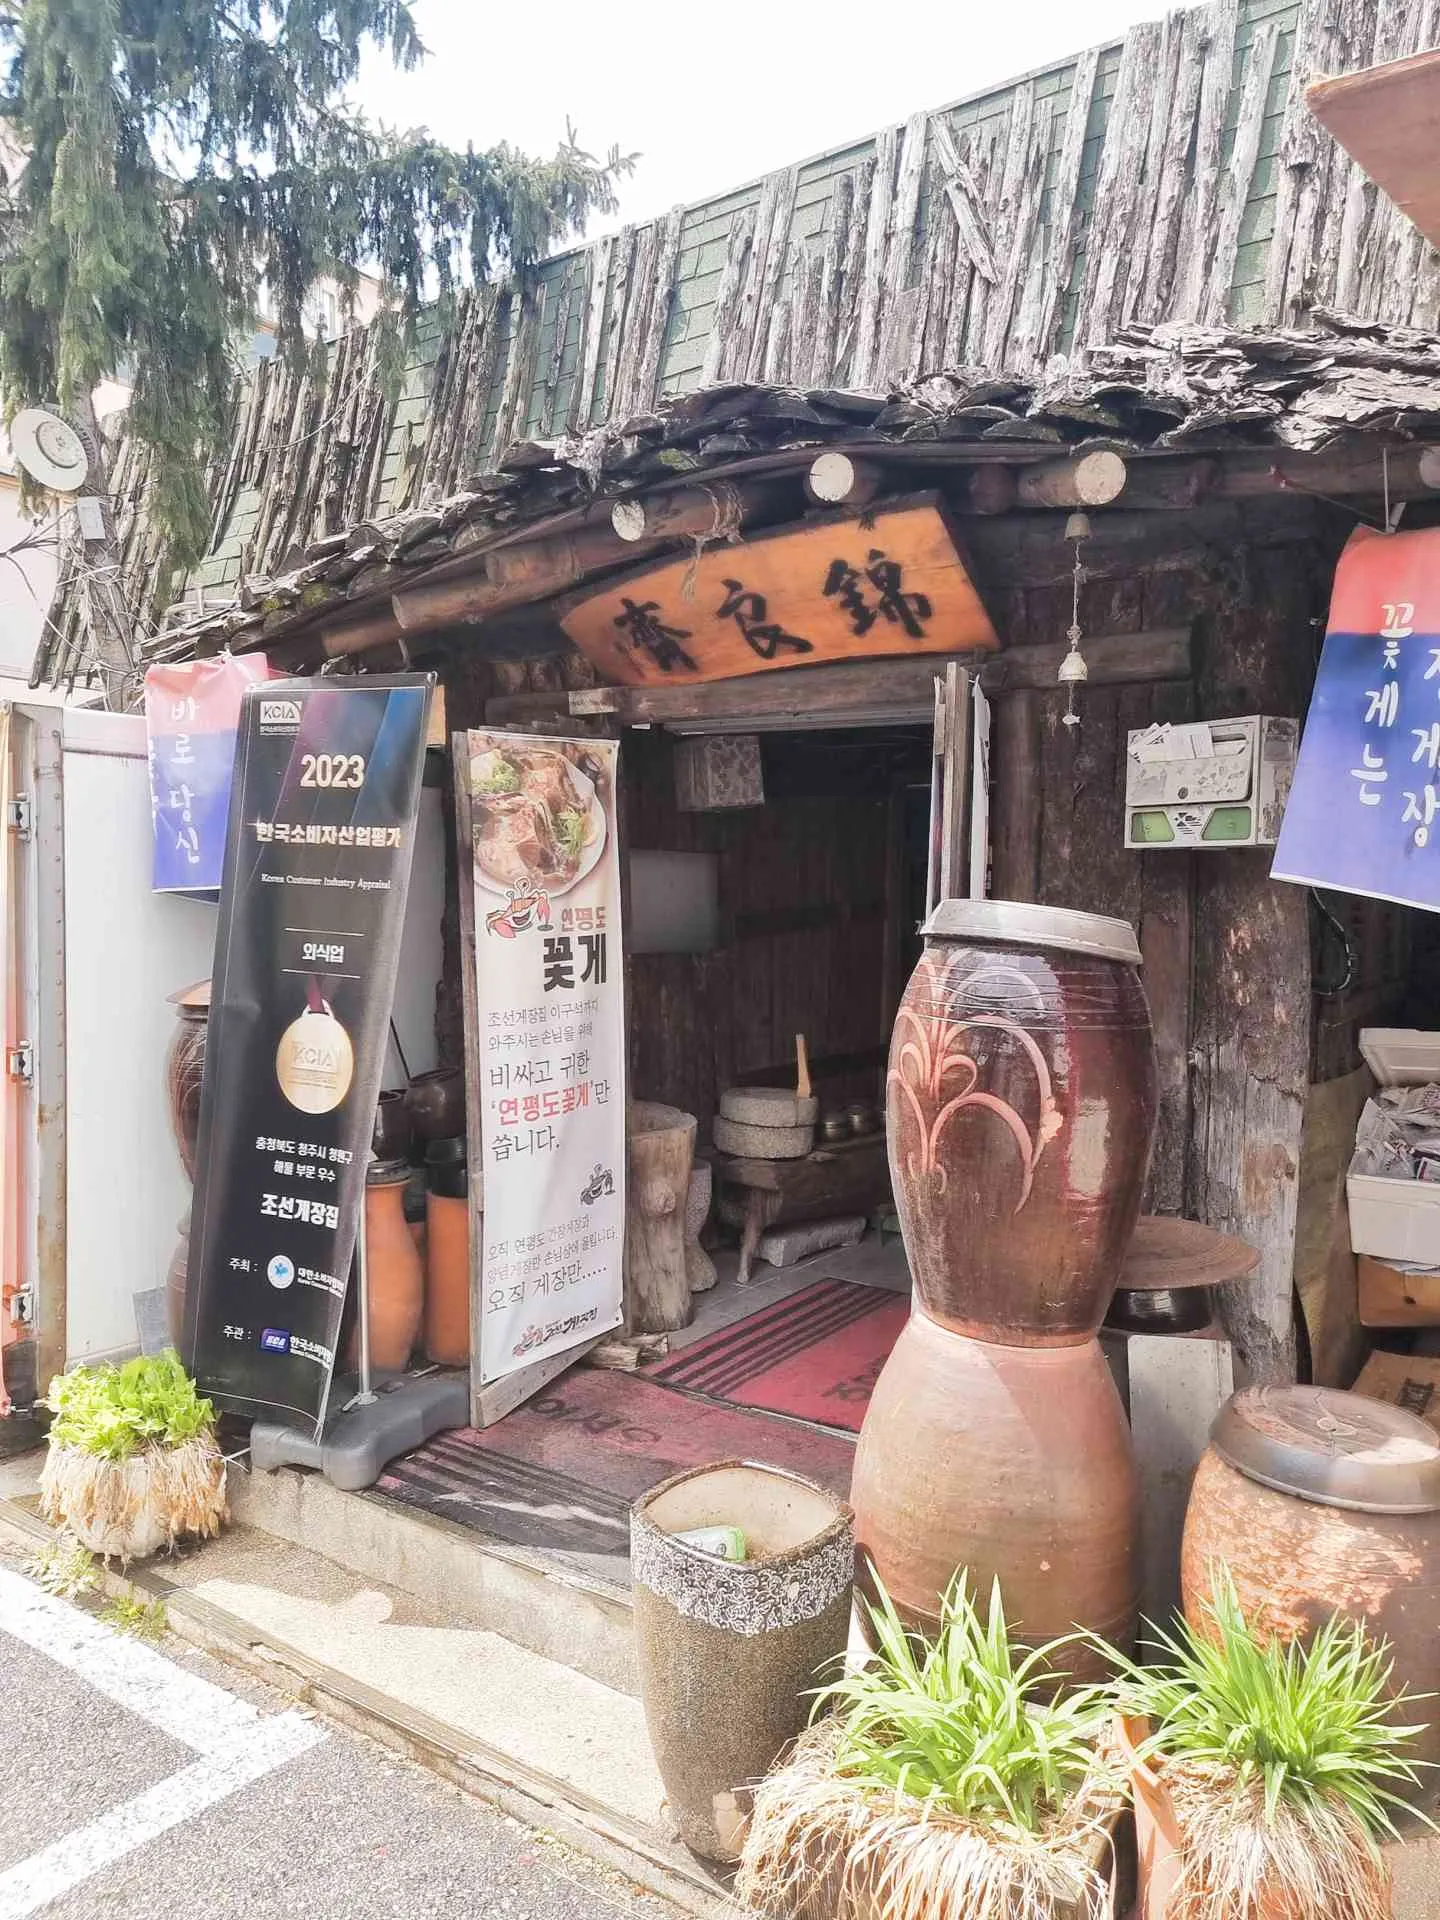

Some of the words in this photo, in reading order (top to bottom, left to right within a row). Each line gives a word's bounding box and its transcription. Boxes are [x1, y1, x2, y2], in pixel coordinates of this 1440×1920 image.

[263, 704, 297, 720] KCIA
[300, 754, 366, 788] 2023
[256, 822, 401, 848] 한국소비자산업평가
[261, 872, 285, 884] Korea
[323, 877, 355, 890] Industry
[356, 877, 392, 890] Appraisal
[561, 906, 607, 932] 연평도
[301, 942, 345, 964] 외식업
[543, 933, 607, 993] 꽃게
[487, 1005, 547, 1028] 조선게장집
[489, 1059, 553, 1089] 비싸고
[559, 1048, 590, 1079] 귀한
[255, 1136, 296, 1155] 충청북도
[297, 1142, 327, 1160] 청주시
[491, 1125, 561, 1162] 씁니다.
[273, 1160, 295, 1176] 해물
[295, 1163, 317, 1179] 부문
[317, 1167, 337, 1183] 우수
[260, 1193, 340, 1230] 조선게장집
[487, 1280, 525, 1315] 오직
[223, 1324, 245, 1341] 주관
